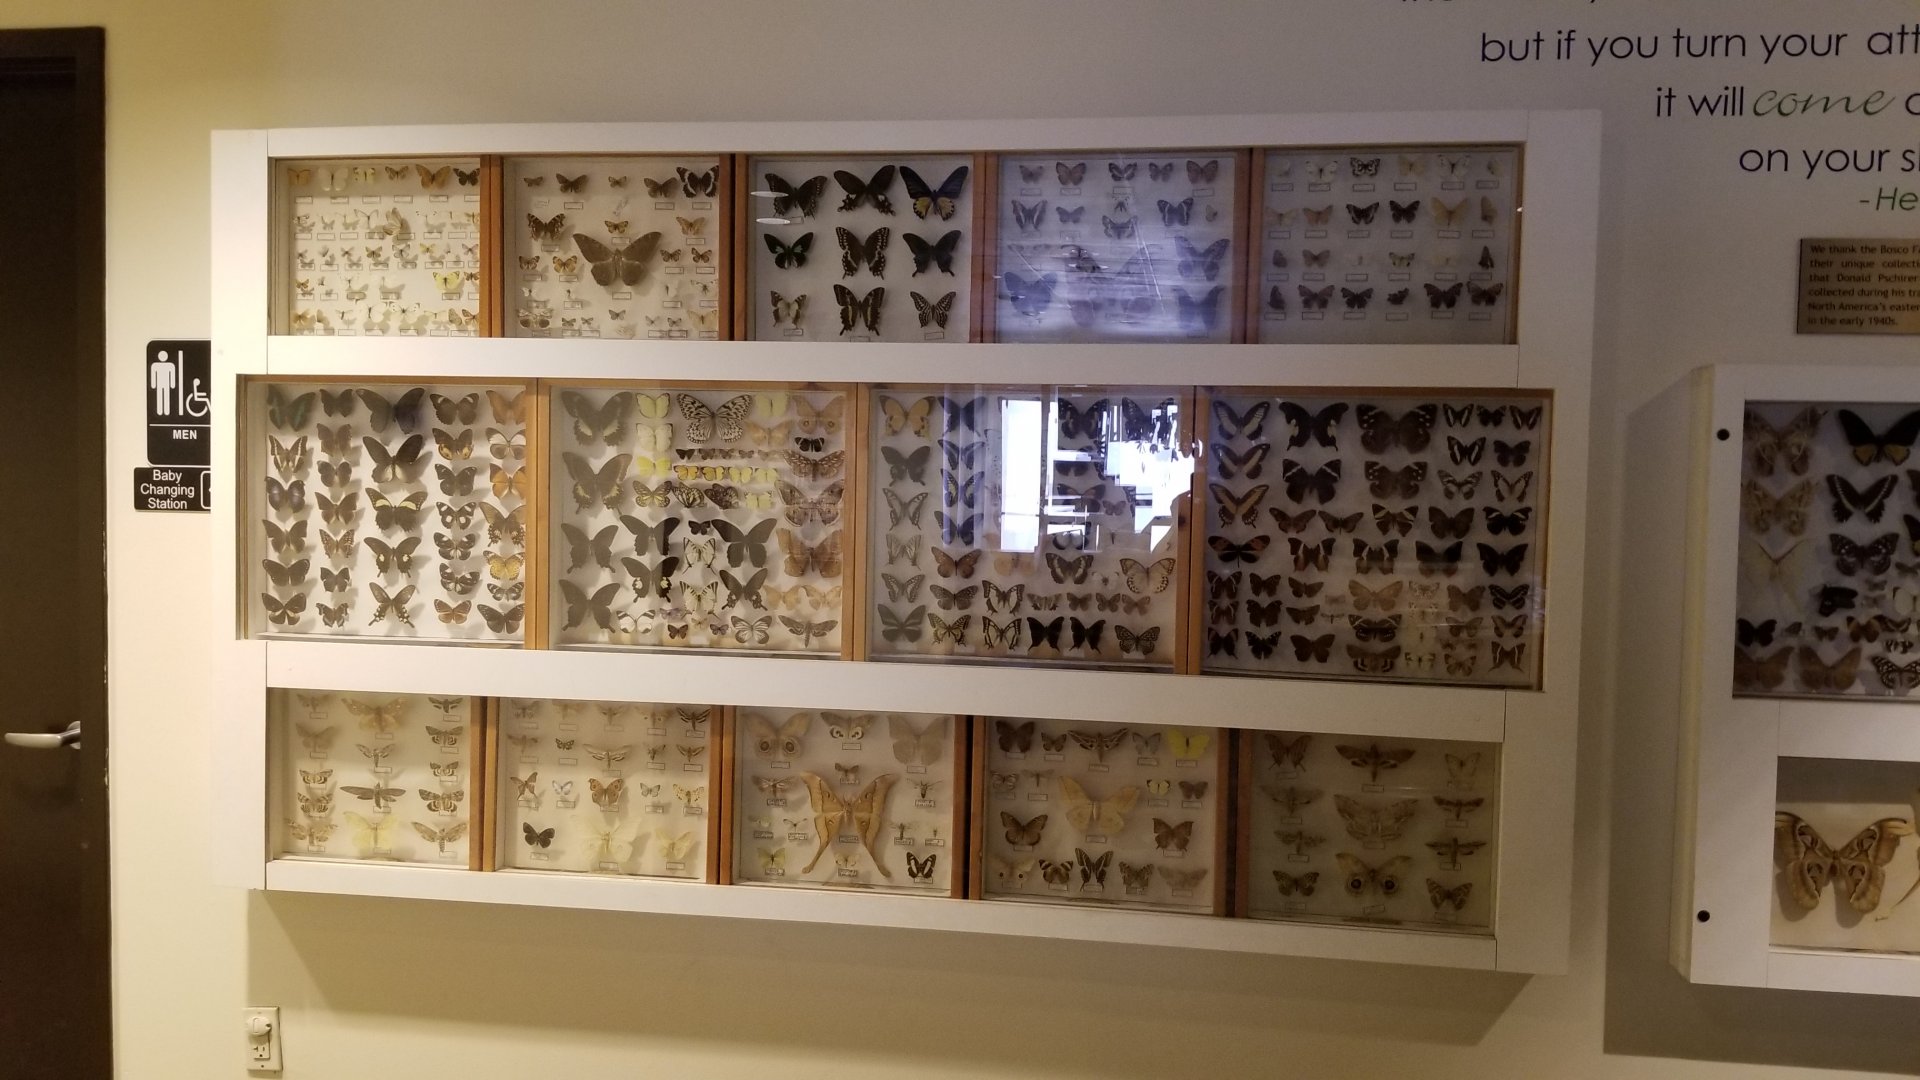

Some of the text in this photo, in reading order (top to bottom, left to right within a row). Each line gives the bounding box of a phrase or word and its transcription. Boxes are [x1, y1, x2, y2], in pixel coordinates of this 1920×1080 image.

[1481, 31, 1545, 62] but
[1556, 29, 1577, 60] if
[1587, 35, 1659, 67] you
[1672, 28, 1747, 58] turn
[1759, 33, 1849, 65] your
[1656, 87, 1677, 117] it
[1687, 86, 1745, 117] will
[1752, 90, 1897, 117] come
[1739, 149, 1789, 172] on
[1801, 149, 1891, 180] your
[1811, 245, 1825, 254] We
[1829, 245, 1856, 254] thank
[1860, 245, 1877, 254] the
[1880, 245, 1909, 254] Bosco
[1810, 259, 1834, 268] their
[1841, 259, 1875, 270] unique
[1809, 274, 1829, 282] that
[1837, 274, 1871, 282] Donald
[1808, 288, 1855, 297] collected
[1857, 288, 1889, 299] during
[1891, 288, 1905, 297] his
[1808, 302, 1836, 311] North
[1838, 302, 1886, 311] America's
[1820, 317, 1838, 325] the
[1839, 317, 1865, 327] early
[172, 429, 198, 440] MEN
[153, 469, 182, 484] Baby
[140, 483, 195, 498] Changing
[148, 498, 188, 509] Station
